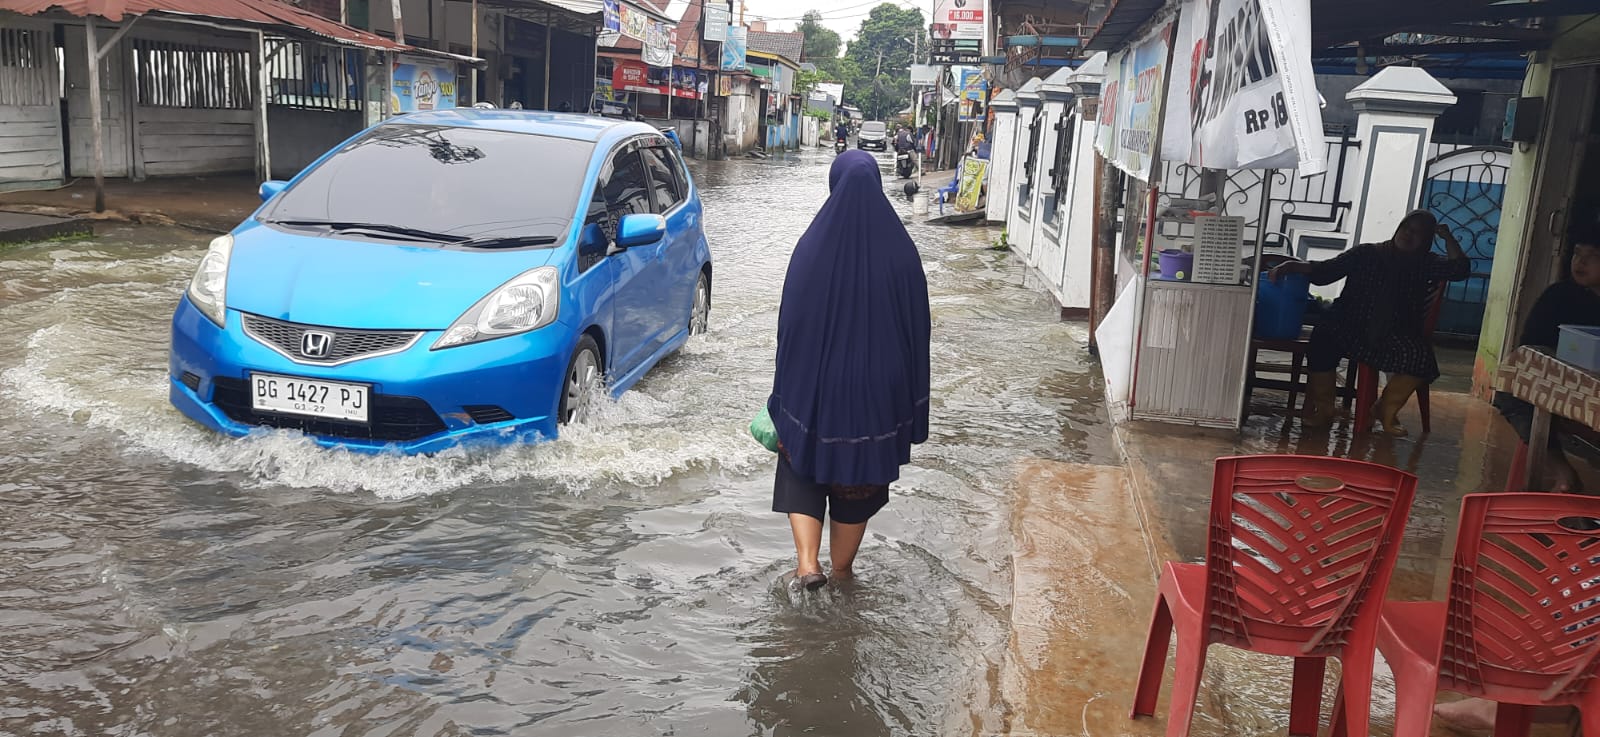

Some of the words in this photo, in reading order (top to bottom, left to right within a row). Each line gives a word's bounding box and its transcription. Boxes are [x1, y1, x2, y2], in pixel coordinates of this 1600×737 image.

[414, 80, 438, 99] Tango
[1244, 109, 1270, 134] Rp
[257, 379, 278, 399] BG
[287, 382, 329, 404] 1427
[340, 388, 362, 408] PJ
